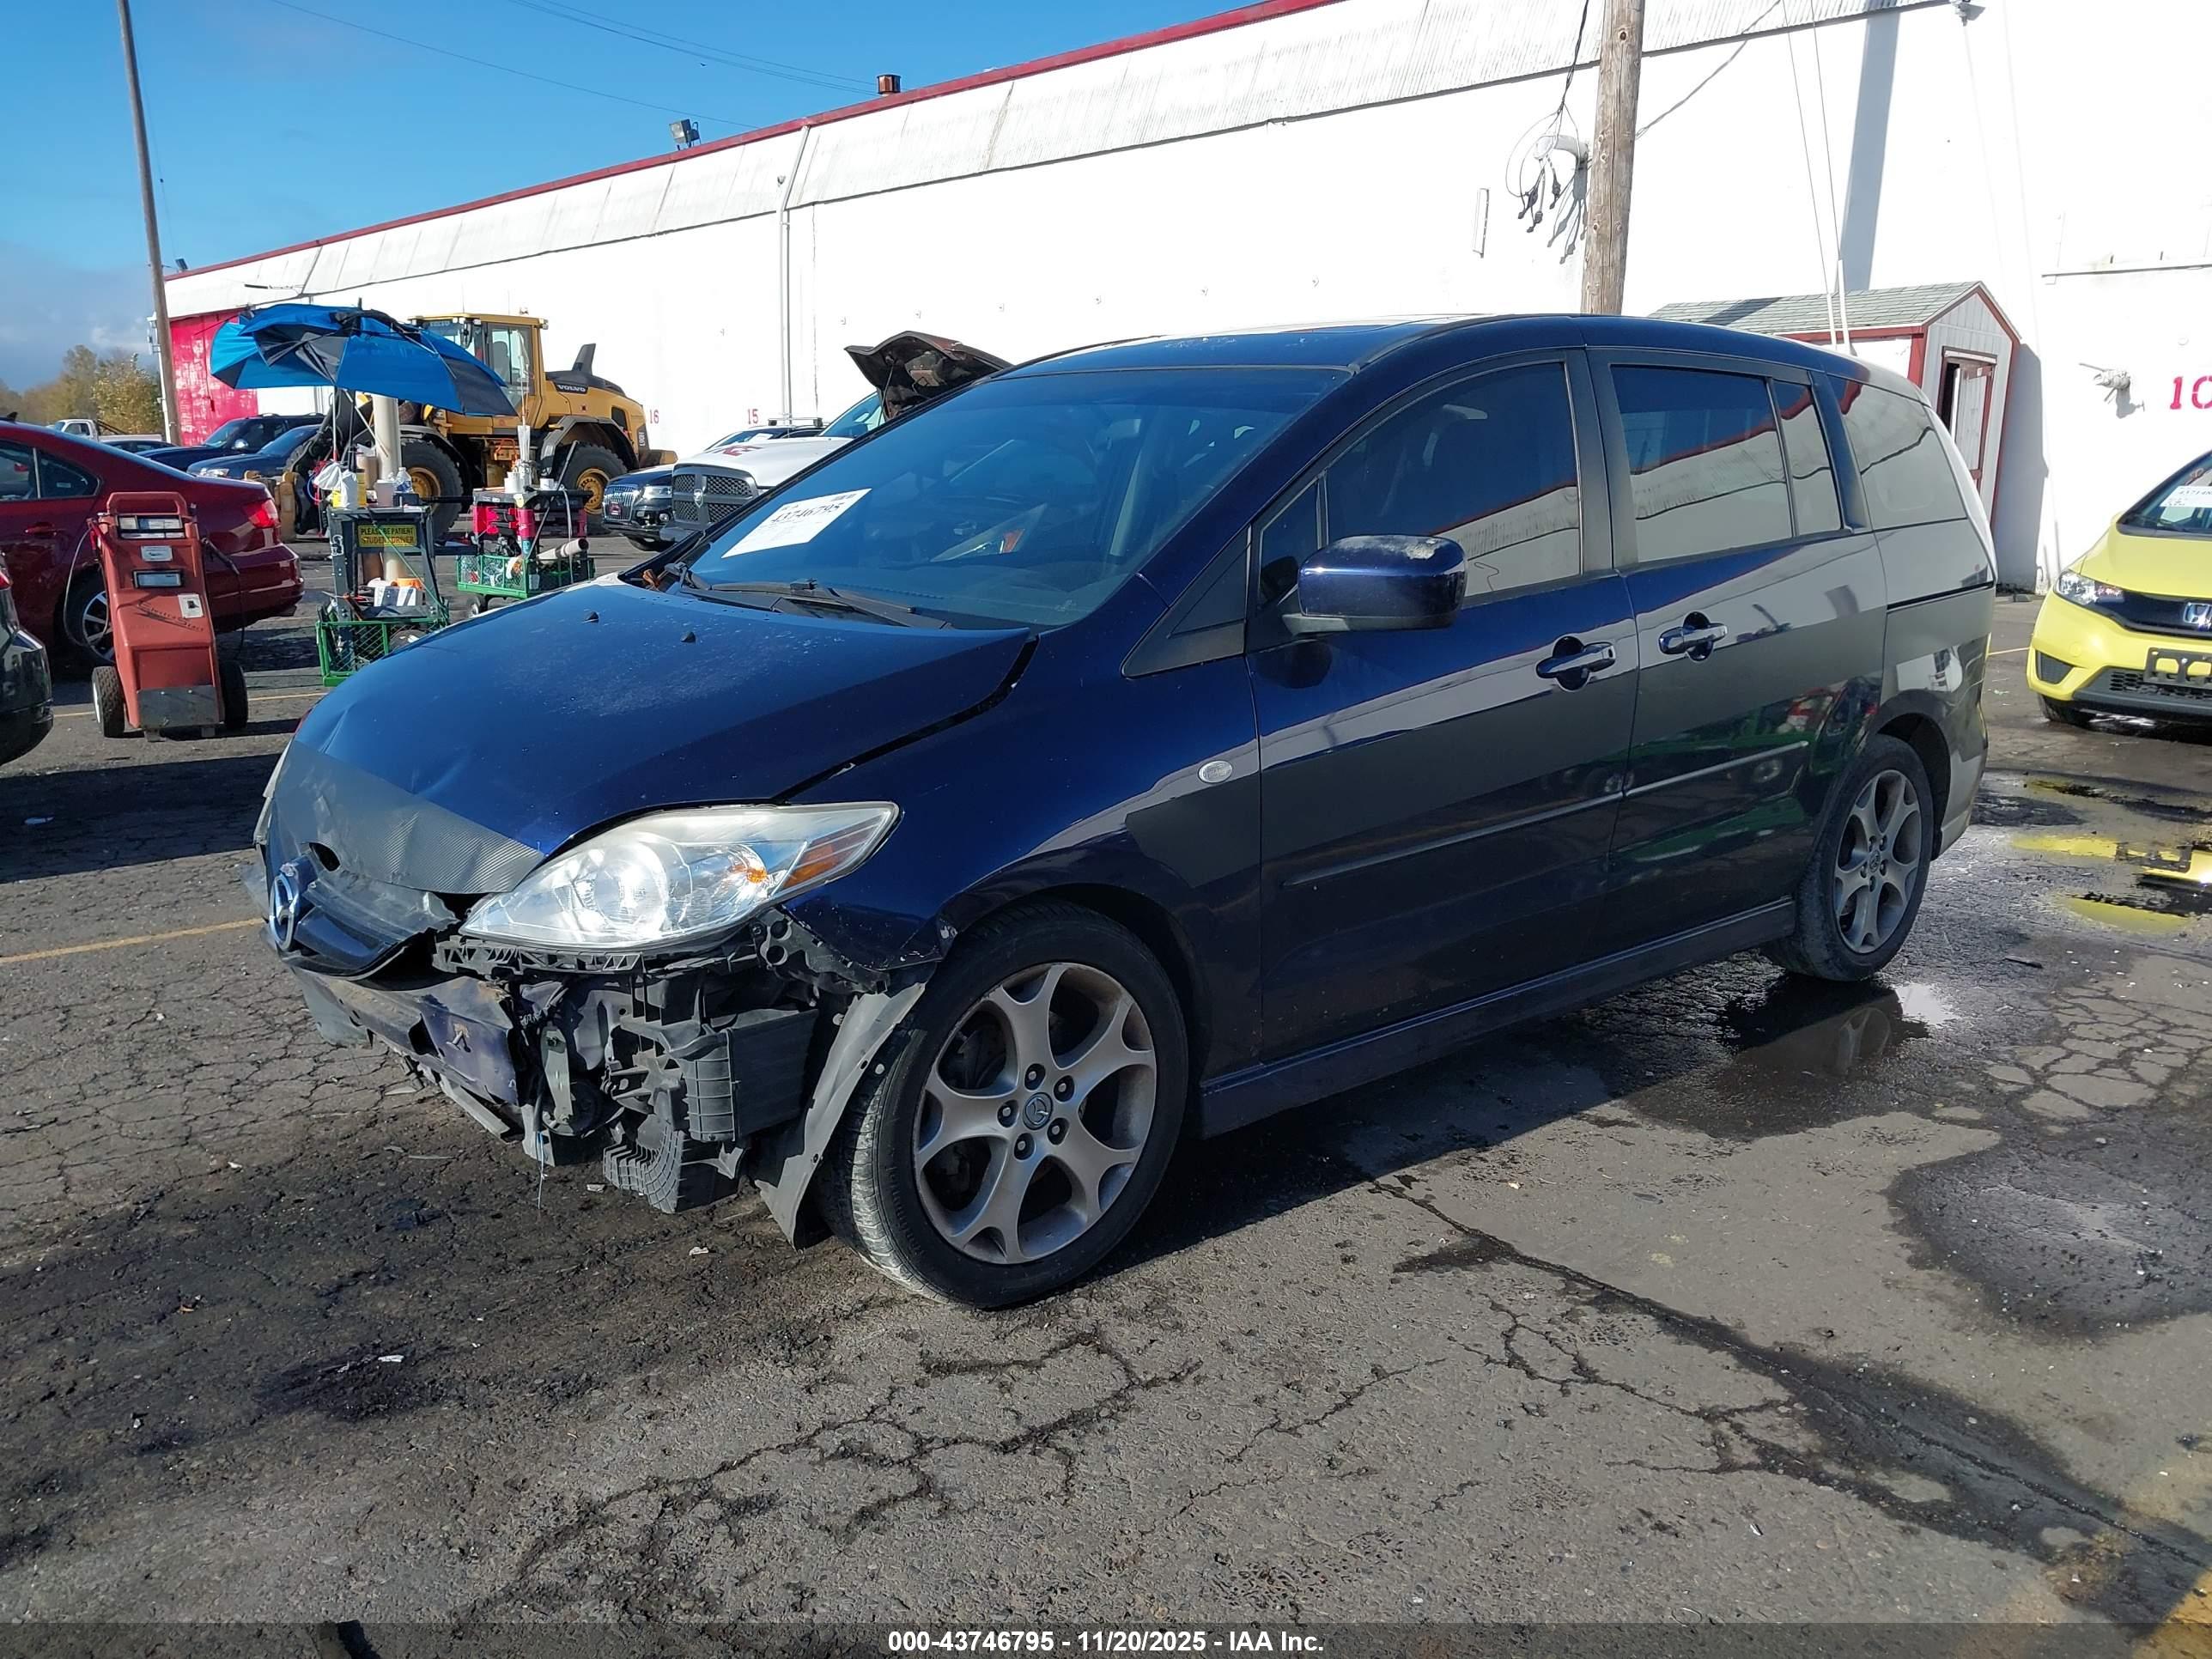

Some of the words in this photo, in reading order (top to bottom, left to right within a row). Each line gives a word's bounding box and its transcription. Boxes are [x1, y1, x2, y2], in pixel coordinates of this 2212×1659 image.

[557, 384, 586, 392] VOLVO
[649, 410, 659, 424] 16
[748, 408, 759, 424] 15
